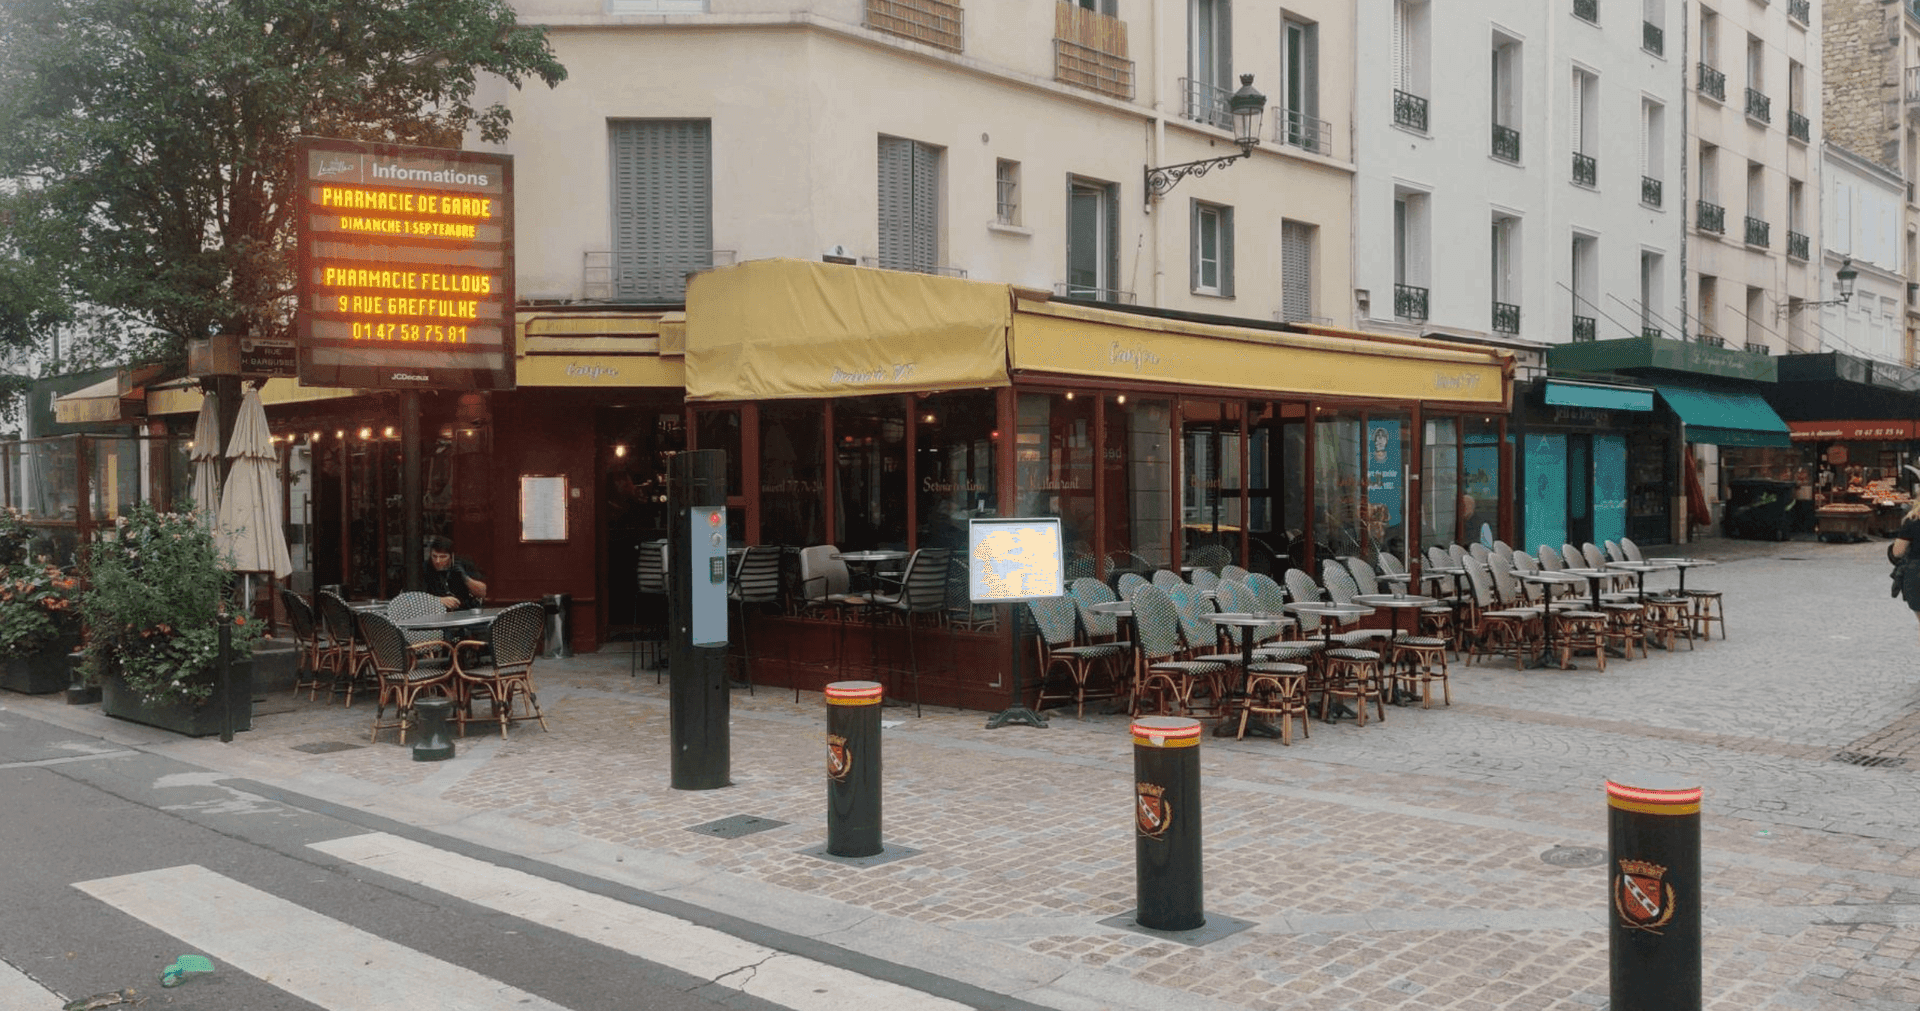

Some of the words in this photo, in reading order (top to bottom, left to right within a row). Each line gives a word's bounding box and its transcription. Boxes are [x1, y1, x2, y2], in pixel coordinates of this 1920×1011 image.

[372, 162, 489, 186] Informations
[322, 187, 414, 212] PHARMACIE
[418, 196, 438, 214] DE
[442, 197, 492, 218] GARDE
[340, 216, 402, 234] DIMANCHE
[404, 220, 410, 233] 1
[412, 220, 476, 239] SEPTEMBRE
[325, 267, 418, 290] PHARMACIE
[421, 273, 491, 294] FELLOUS
[338, 295, 349, 313] 9
[353, 295, 384, 314] RUE
[387, 298, 478, 319] GREFFULHE
[352, 322, 372, 340] 01
[377, 323, 396, 340] 47
[400, 324, 420, 341] 58
[425, 325, 444, 342] 75
[448, 326, 468, 344] 81
[391, 373, 430, 382] JCDecaux
